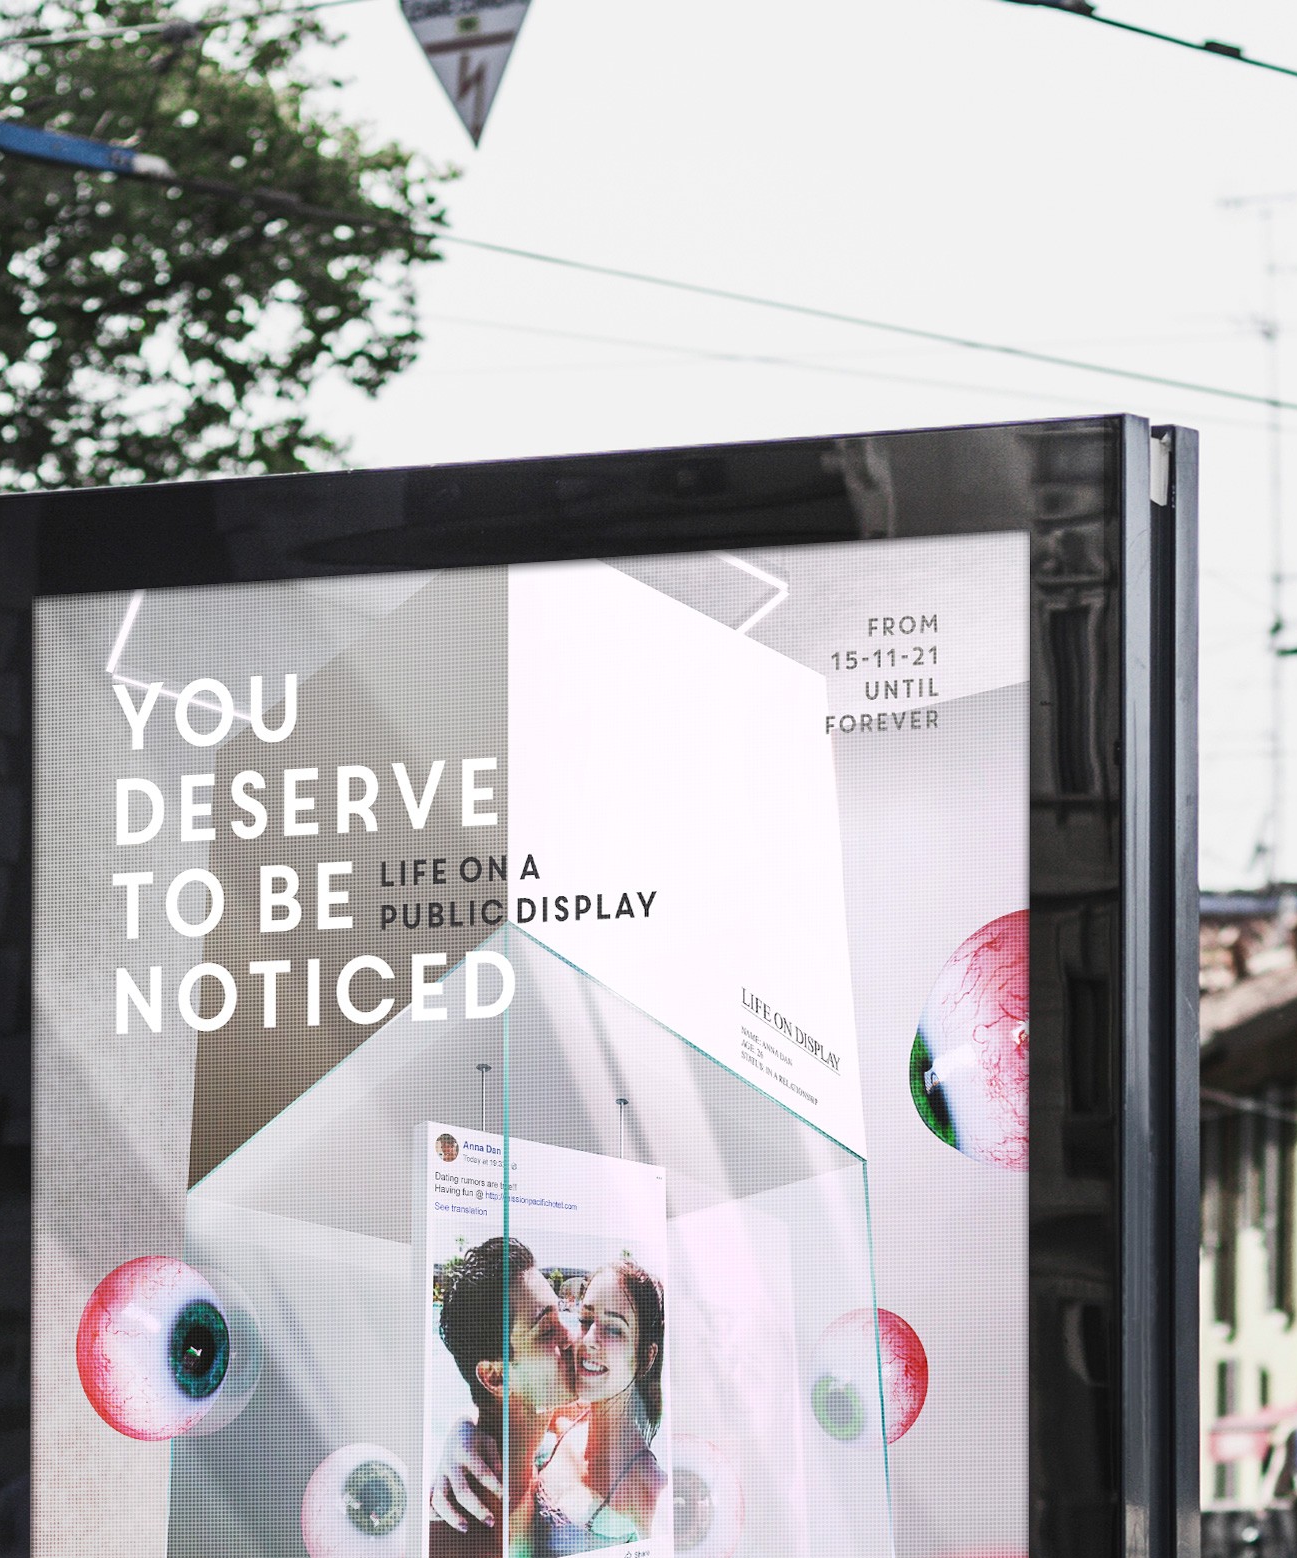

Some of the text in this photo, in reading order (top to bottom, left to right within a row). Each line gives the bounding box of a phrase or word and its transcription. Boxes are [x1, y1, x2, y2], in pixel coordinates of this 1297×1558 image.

[868, 614, 938, 637] FROM
[831, 645, 938, 670] 15-11-21
[865, 677, 939, 700] UNTIL
[112, 673, 298, 750] YOU
[825, 710, 939, 735] FOREVER
[115, 757, 499, 846] DESERVE
[381, 854, 540, 887] LIFE ON A
[112, 861, 354, 939] TO BE
[381, 891, 657, 930] PUBLIC DISPLAY
[115, 950, 516, 1035] NOTICED
[741, 986, 841, 1071] LIFE ON DISPLAY
[463, 1141, 501, 1155] Anna Dan
[434, 1171, 459, 1185] Dating
[460, 1177, 485, 1187] rumors
[487, 1181, 499, 1189] are
[434, 1184, 461, 1197] Having
[462, 1187, 474, 1197] fun
[434, 1201, 488, 1216] See translation
